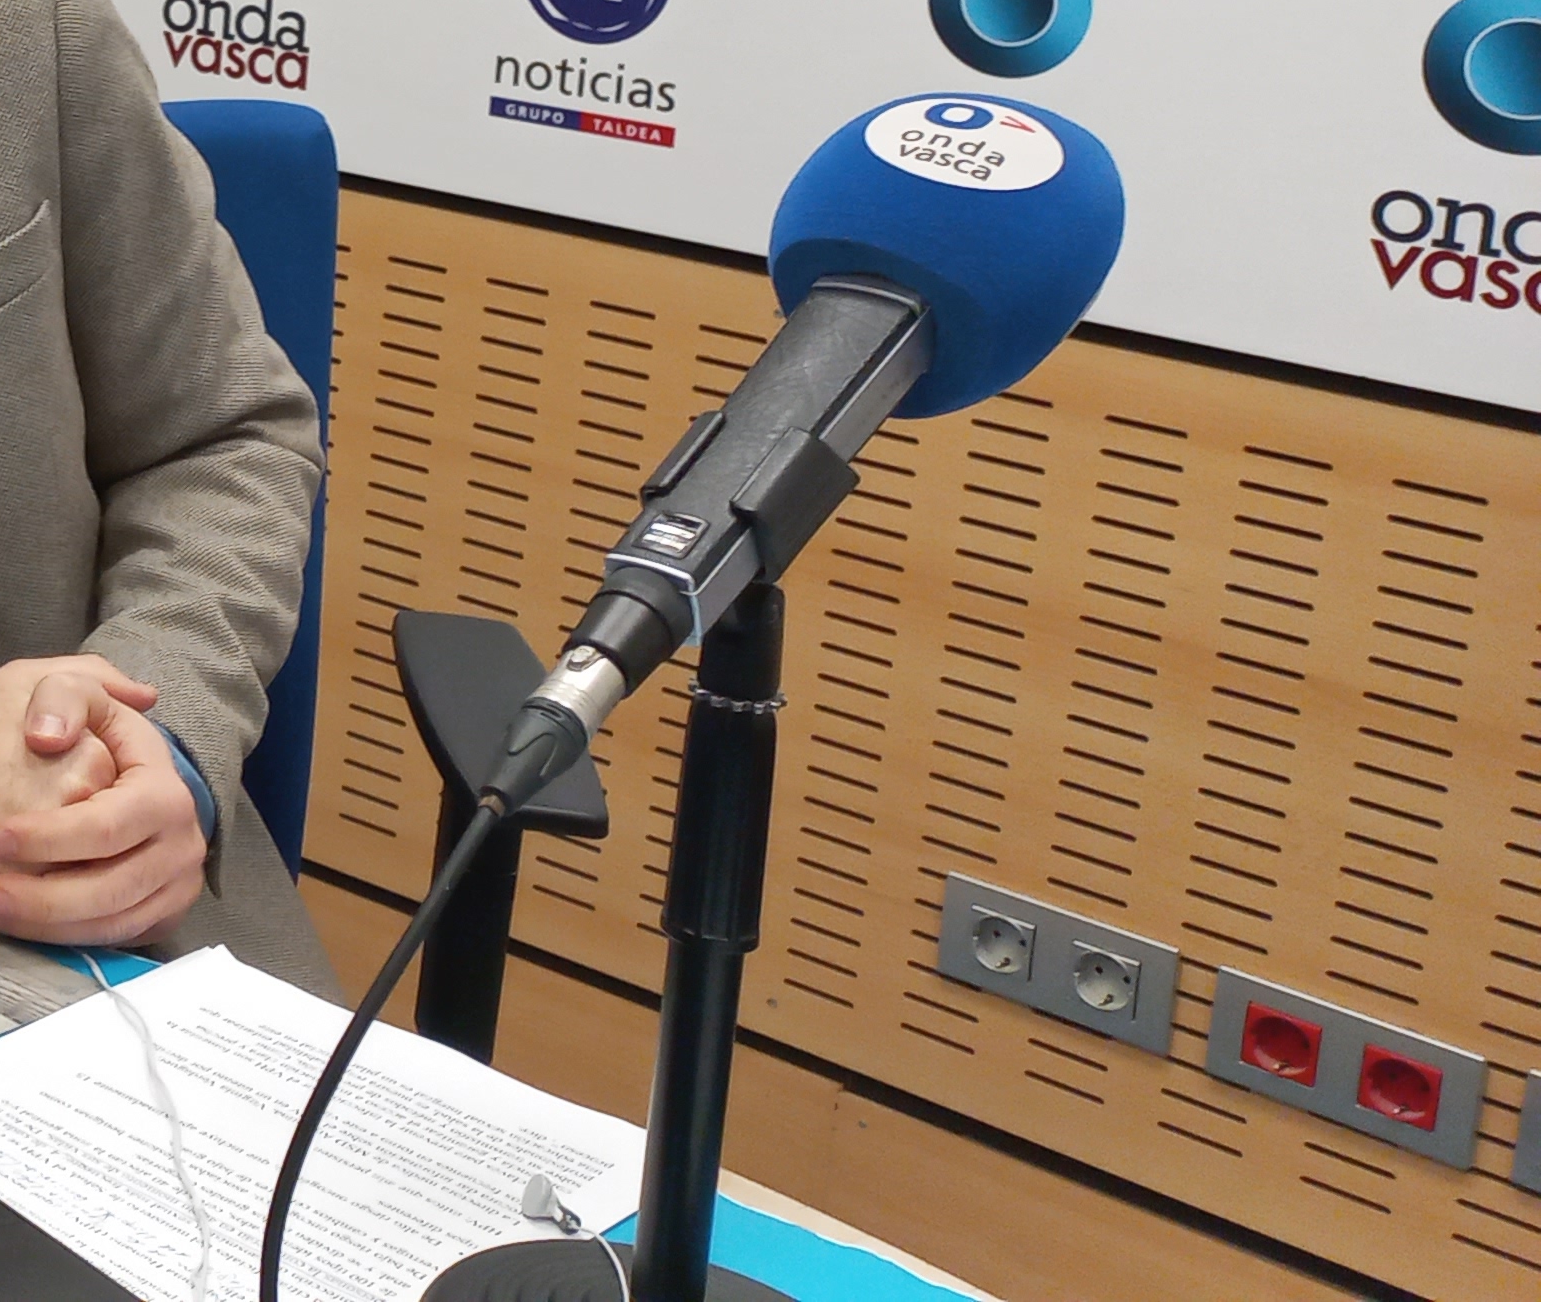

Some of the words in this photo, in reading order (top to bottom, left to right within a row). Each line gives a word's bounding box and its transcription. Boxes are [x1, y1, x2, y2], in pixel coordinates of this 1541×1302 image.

[162, 33, 310, 91] vasca
[492, 51, 678, 114] noticias
[502, 101, 566, 128] GRUPO
[591, 117, 666, 146] TALDEA
[899, 143, 992, 182] vasca
[900, 129, 1006, 168] onda
